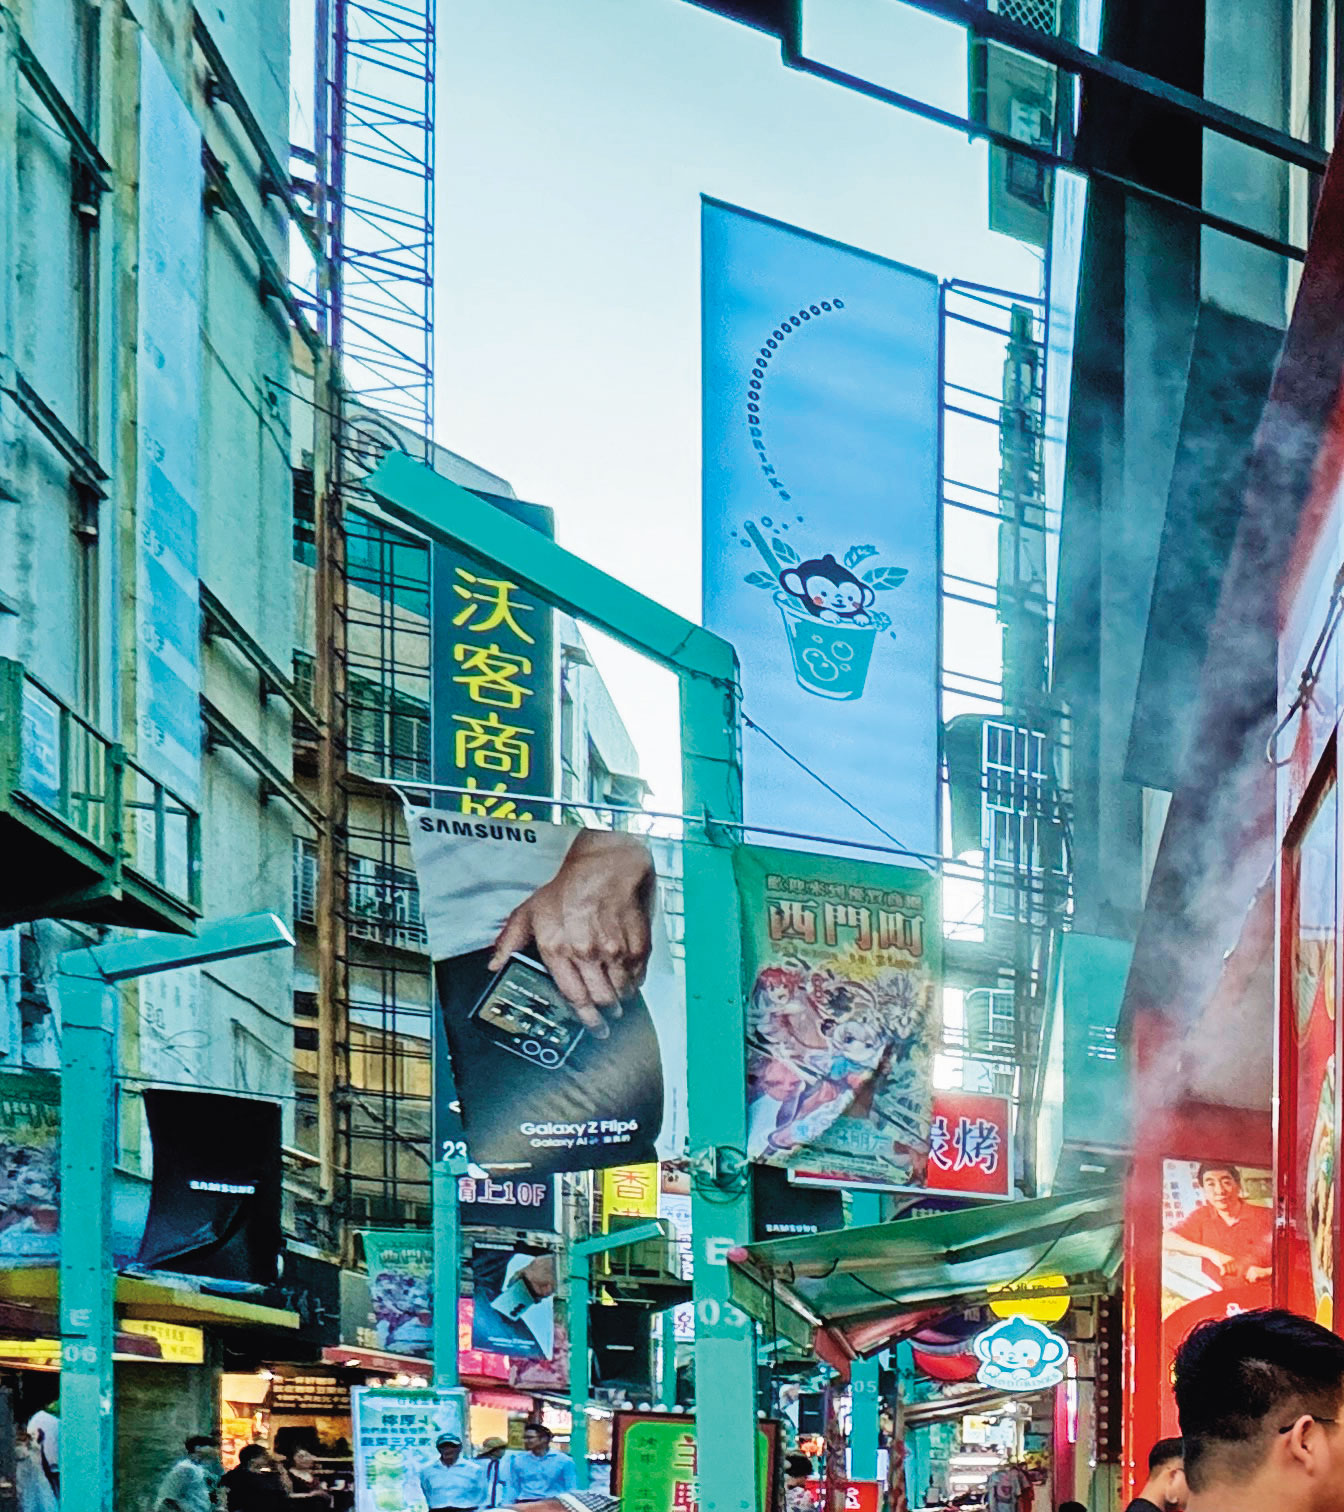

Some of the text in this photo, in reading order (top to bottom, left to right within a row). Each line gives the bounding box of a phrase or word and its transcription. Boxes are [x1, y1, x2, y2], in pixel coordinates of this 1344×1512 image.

[419, 816, 538, 844] SAMSUNG
[767, 899, 926, 957] 西門町
[520, 1119, 639, 1138] Galaxy Z Flip6
[530, 1137, 575, 1149] Galaxy
